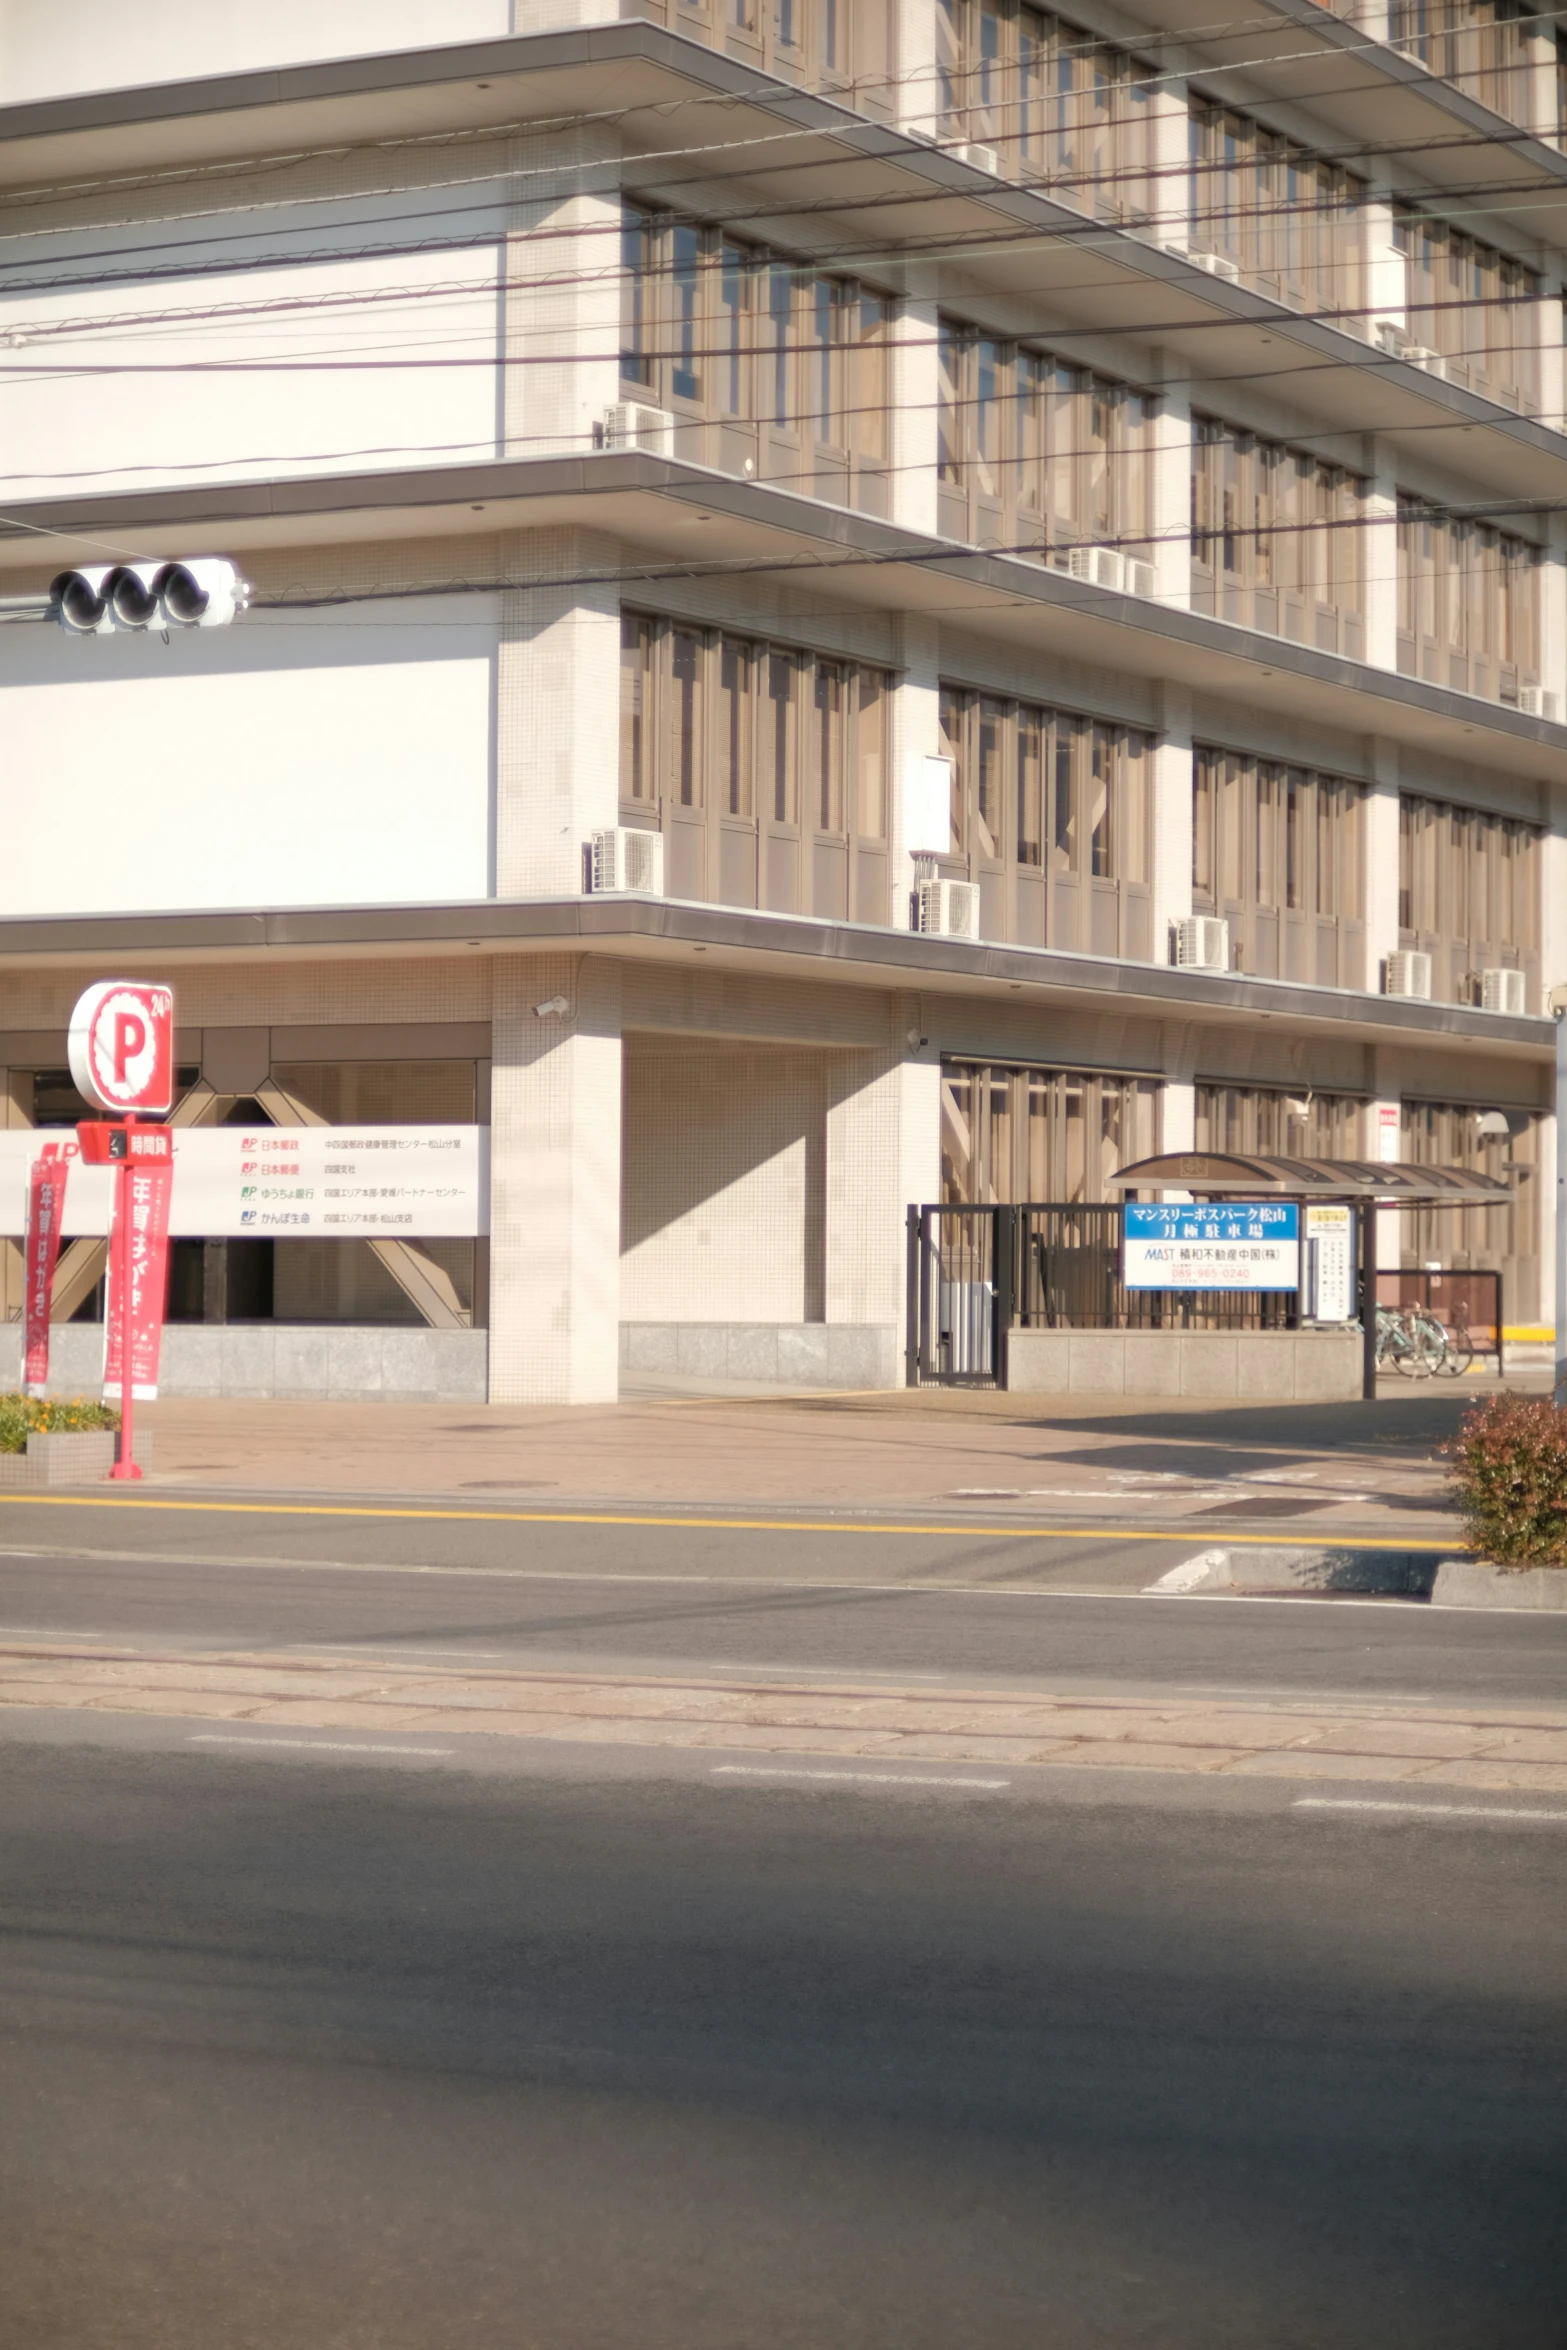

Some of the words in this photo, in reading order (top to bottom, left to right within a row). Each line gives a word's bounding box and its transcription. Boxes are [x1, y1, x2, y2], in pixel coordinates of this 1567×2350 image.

[115, 1012, 146, 1084] P
[130, 1135, 167, 1156] 時間貸
[261, 1140, 299, 1151] 日本郵政
[261, 1164, 300, 1175] 日本郵便
[324, 1164, 356, 1174] 四国支社
[261, 1188, 315, 1200] ゆうちょ銀行
[261, 1212, 310, 1224] かんぽ生命
[1163, 1223, 1264, 1239] 月極駐車場
[1144, 1248, 1175, 1261] MAST
[1180, 1248, 1281, 1261] 積和不動産中国(株)
